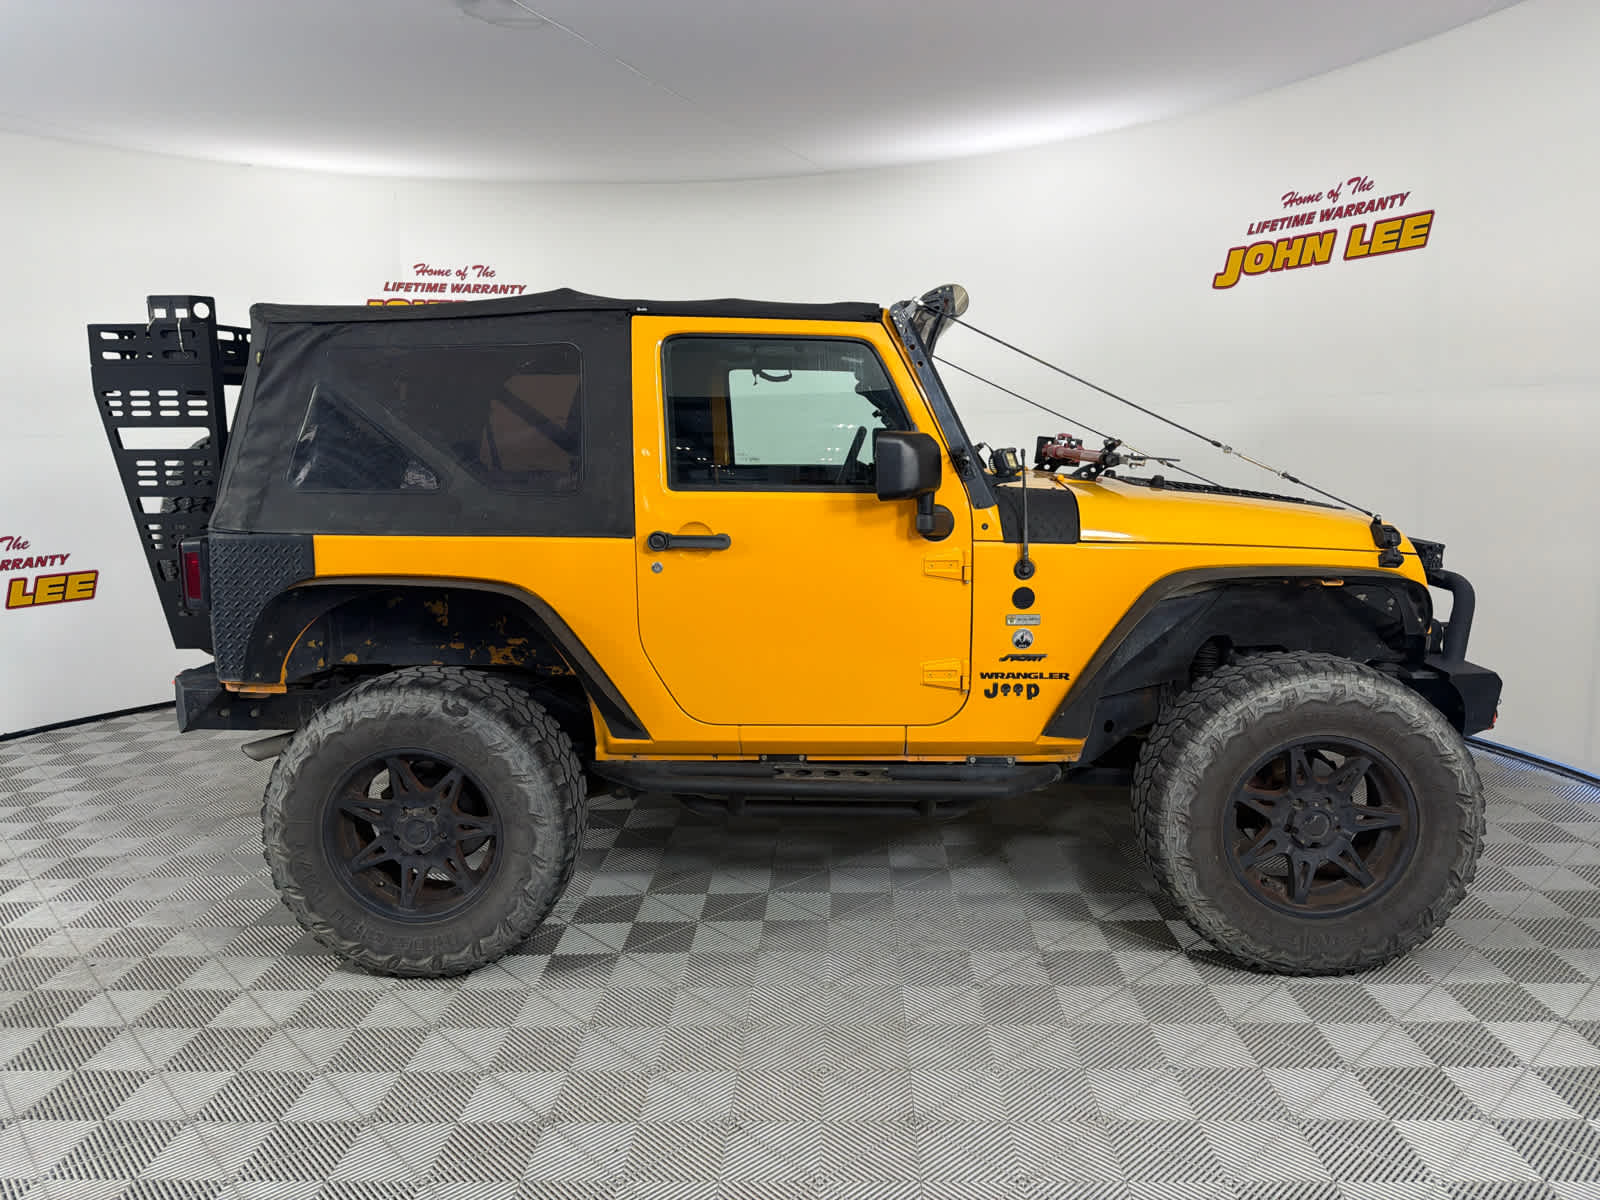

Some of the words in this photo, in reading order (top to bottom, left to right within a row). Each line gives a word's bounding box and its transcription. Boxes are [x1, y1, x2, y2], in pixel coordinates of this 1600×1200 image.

[1281, 191, 1323, 209] Home
[1327, 182, 1343, 203] of
[1347, 175, 1375, 196] The
[1247, 210, 1315, 236] LIFETIME
[1319, 191, 1411, 223] WARRANTY
[1212, 229, 1338, 290] JOHN
[1343, 209, 1435, 261] LEE
[413, 263, 452, 277] Home
[455, 266, 468, 280] of
[472, 265, 496, 278] The
[384, 281, 447, 293] LIFETIME
[451, 283, 527, 295] WARRANTY
[0, 536, 31, 552] The
[5, 569, 99, 610] LEE
[980, 672, 1070, 680] WRANGLER
[984, 682, 1040, 700] Jp
